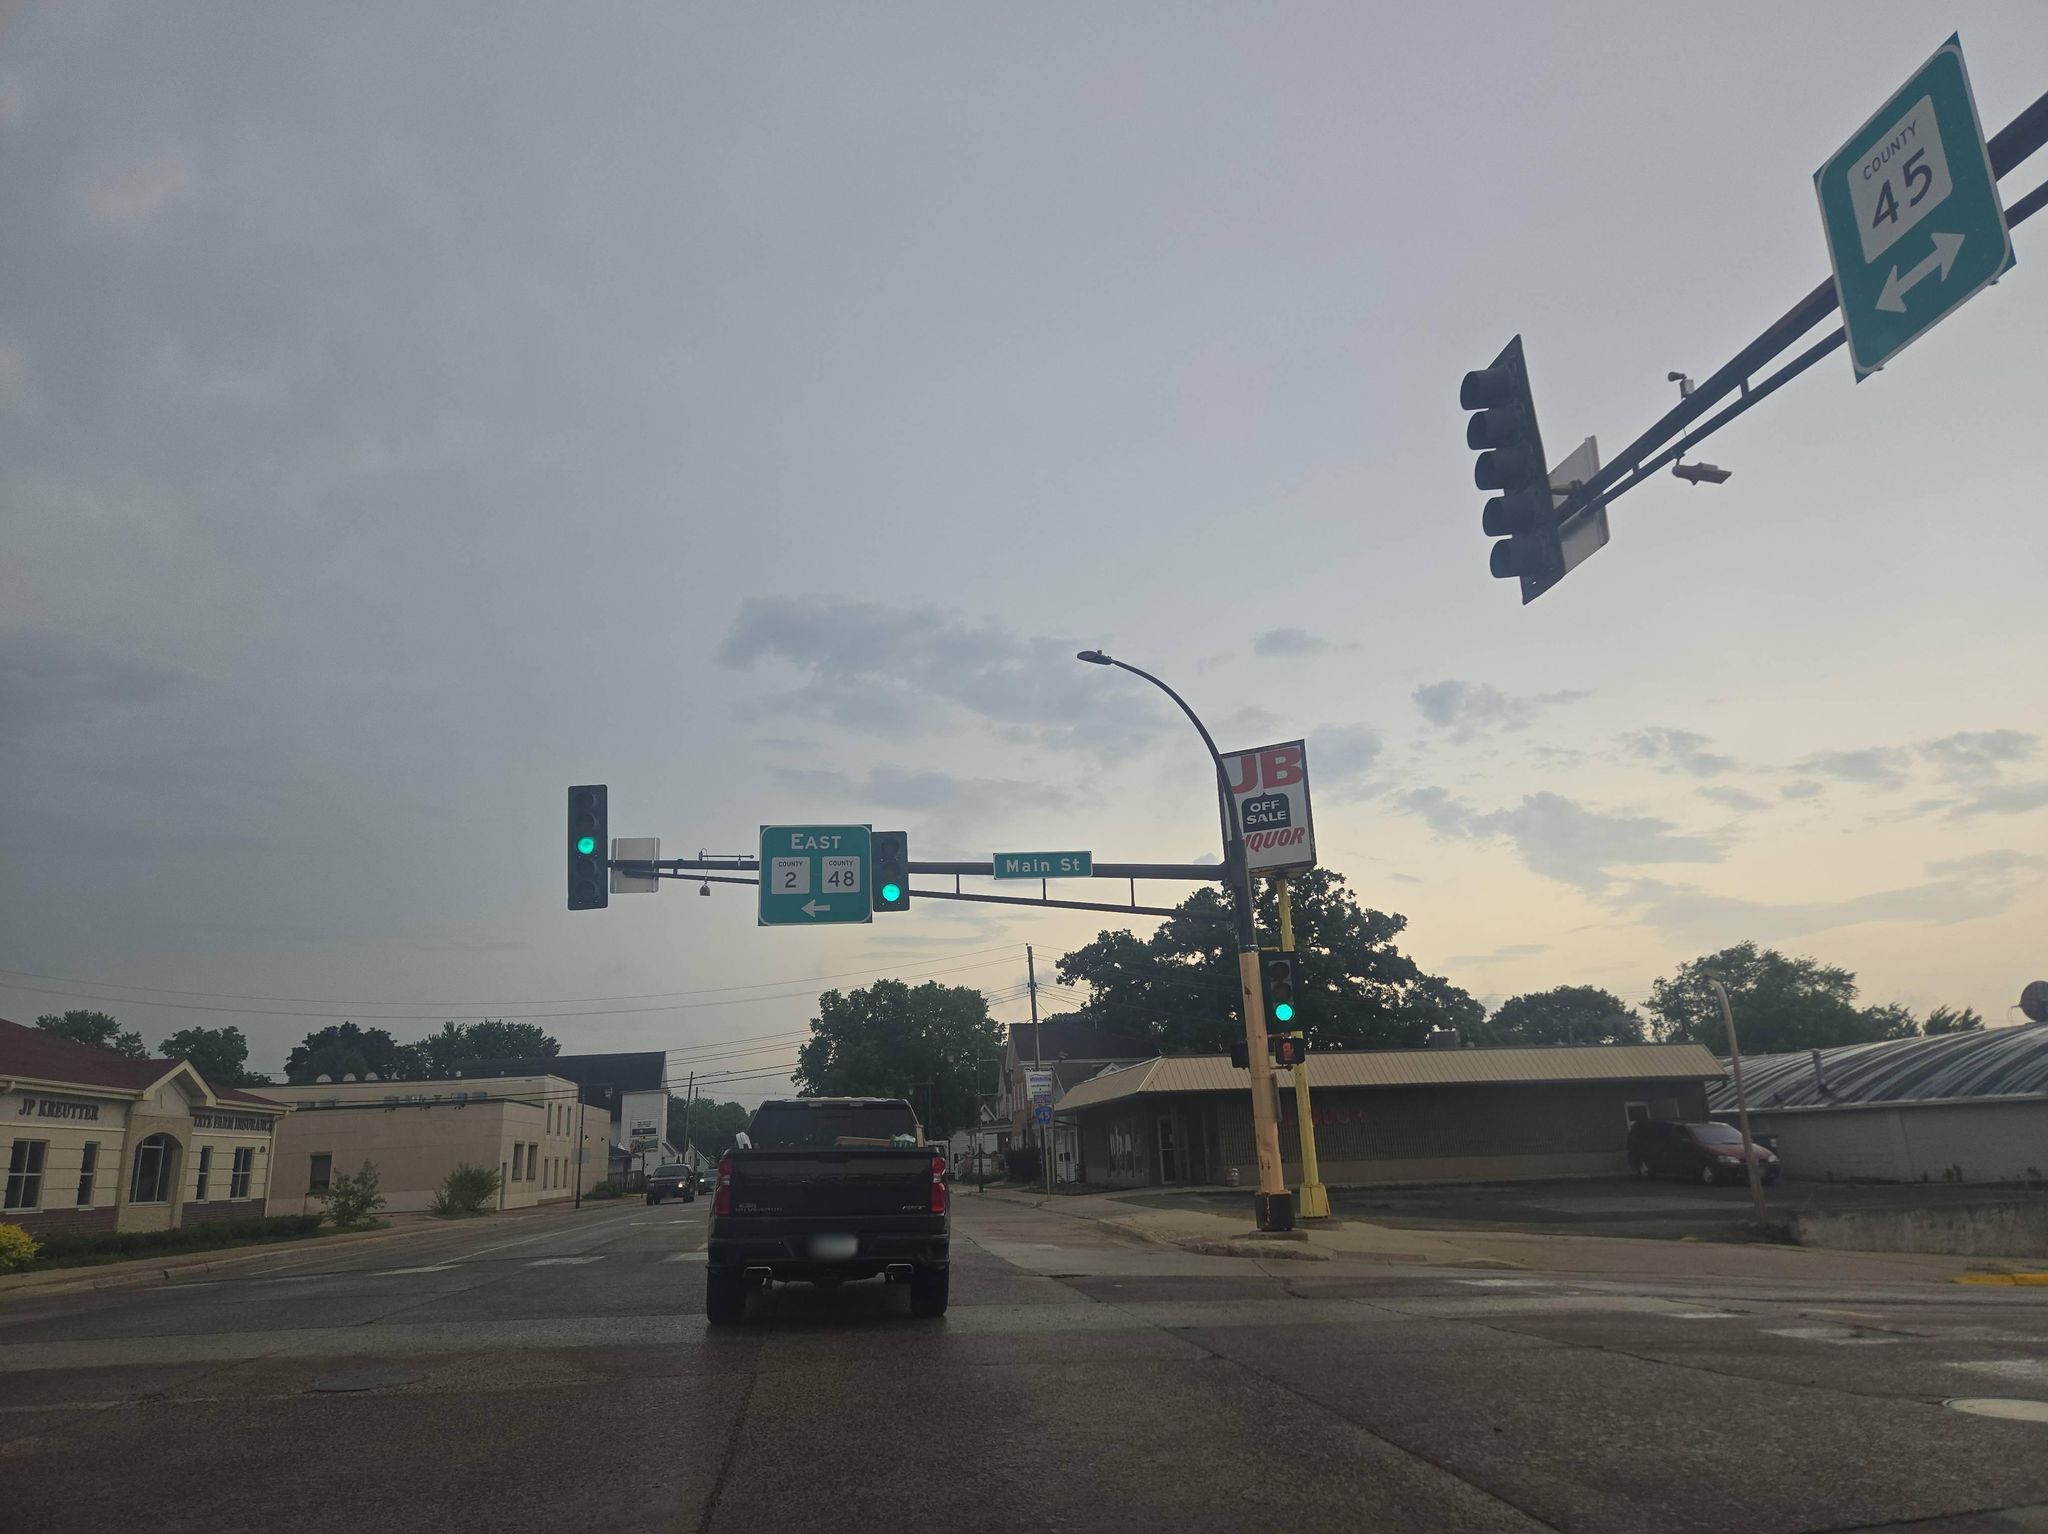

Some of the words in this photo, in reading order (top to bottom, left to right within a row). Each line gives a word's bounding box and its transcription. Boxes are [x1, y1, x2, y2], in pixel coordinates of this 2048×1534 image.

[1863, 119, 1917, 181] COUNTY
[1872, 147, 1933, 230] 45
[1231, 747, 1304, 795] JB
[1249, 800, 1280, 813] OFF
[1246, 810, 1287, 825] SALE
[791, 833, 841, 850] EAST
[1243, 827, 1305, 852] IQUOR
[1006, 858, 1050, 873] Main
[1060, 857, 1080, 872] St
[784, 872, 797, 889] 2
[827, 870, 855, 888] 48
[18, 1098, 36, 1116] JP
[194, 1114, 213, 1129] TATE
